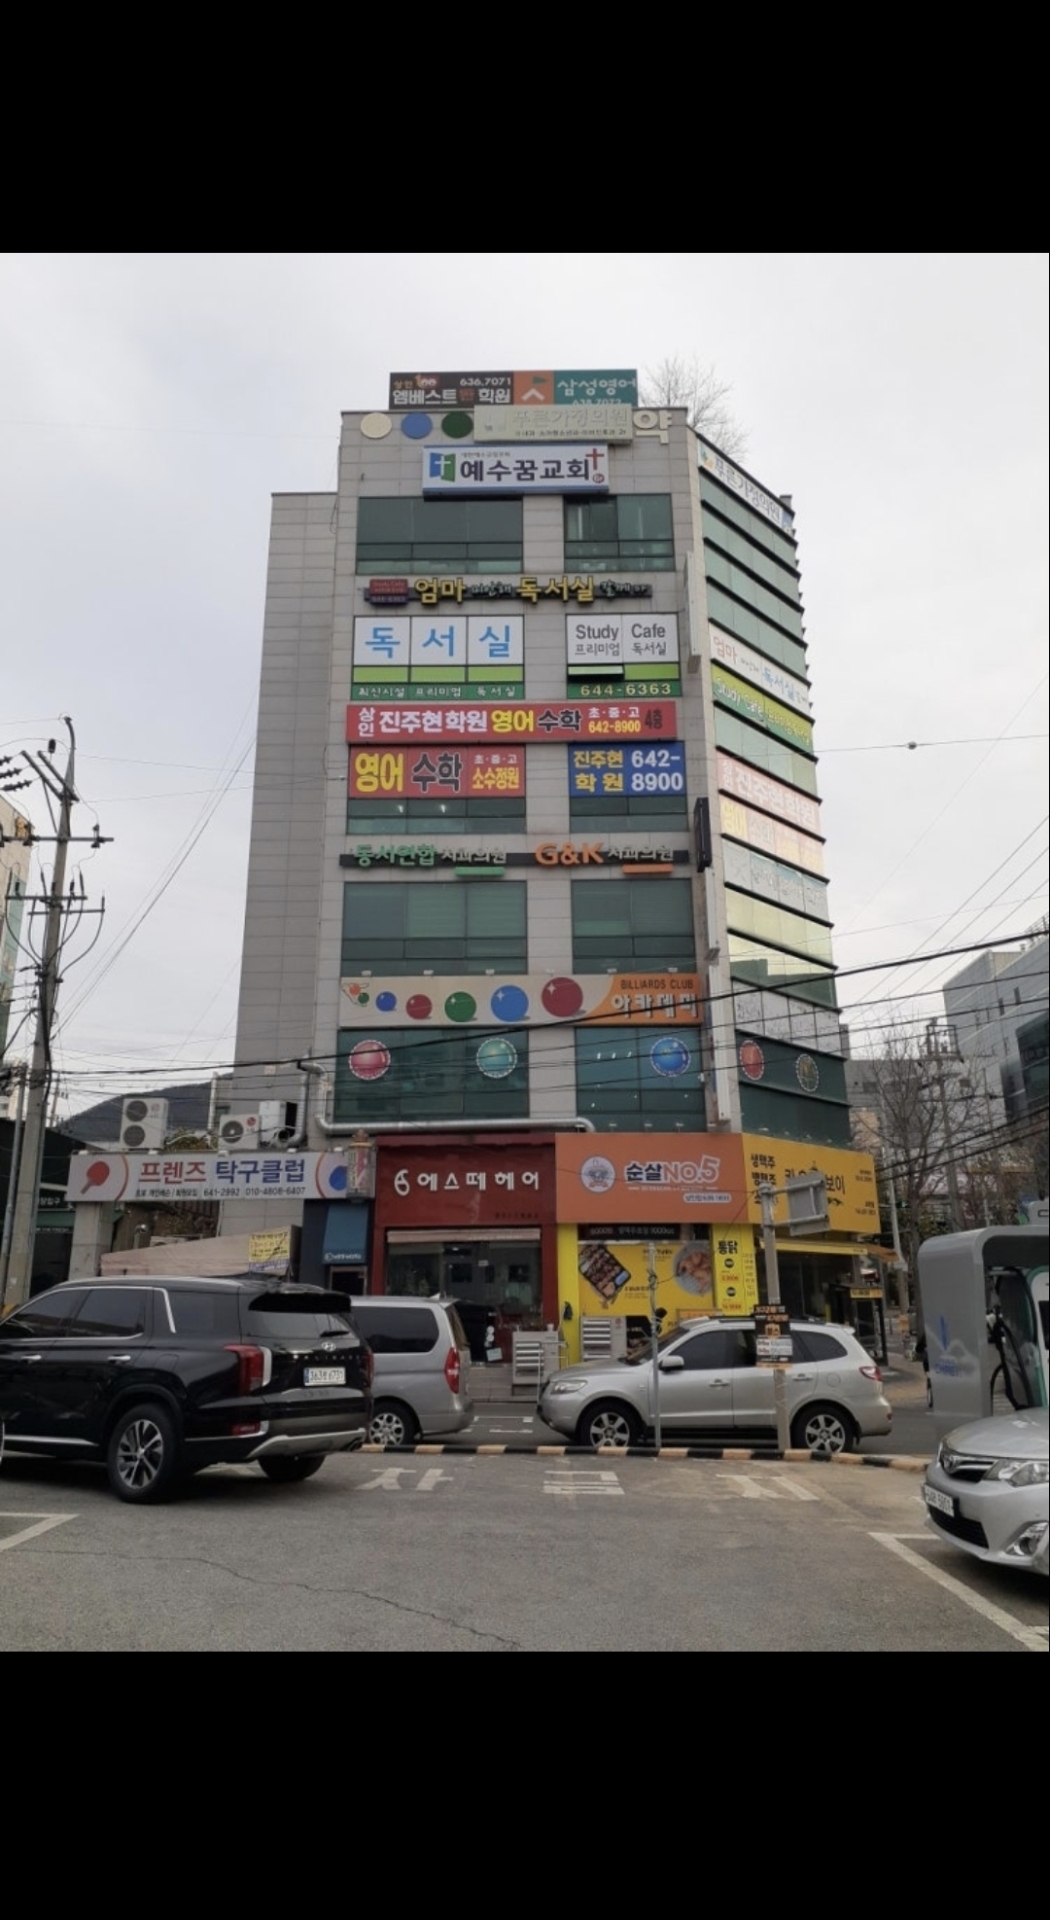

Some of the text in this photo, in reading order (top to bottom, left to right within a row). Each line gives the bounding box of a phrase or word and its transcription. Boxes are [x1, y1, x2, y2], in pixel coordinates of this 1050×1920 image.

[460, 377, 511, 386] 636.7071
[557, 378, 637, 396] 삼성영어
[393, 389, 457, 404] 엠베스트
[478, 388, 511, 403] 학원
[633, 410, 672, 444] 약
[460, 459, 589, 482] 예수꿈교회
[414, 577, 467, 603] 엄마
[516, 575, 594, 602] 독서실
[576, 623, 666, 640] Study Cafe
[575, 641, 666, 656] 프리미엄 독서실
[580, 683, 671, 696] 644-6363
[358, 707, 375, 737] 상인
[538, 708, 582, 732] 수학
[588, 720, 641, 733] 642-8900
[573, 750, 623, 768] 진주현
[631, 750, 681, 768] 642-
[355, 751, 462, 793] 영어 수학
[471, 767, 520, 790] 소수정원
[631, 772, 683, 791] 8900
[535, 842, 604, 867] G&K
[621, 980, 693, 989] BILLIARDS CLUB
[611, 993, 698, 1018] 아카데미
[138, 1159, 305, 1185] 프렌즈 탁구클럽
[417, 1171, 539, 1192] 에스떼헤어
[203, 1188, 240, 1197] 641-2992
[717, 1240, 738, 1255] 통닭
